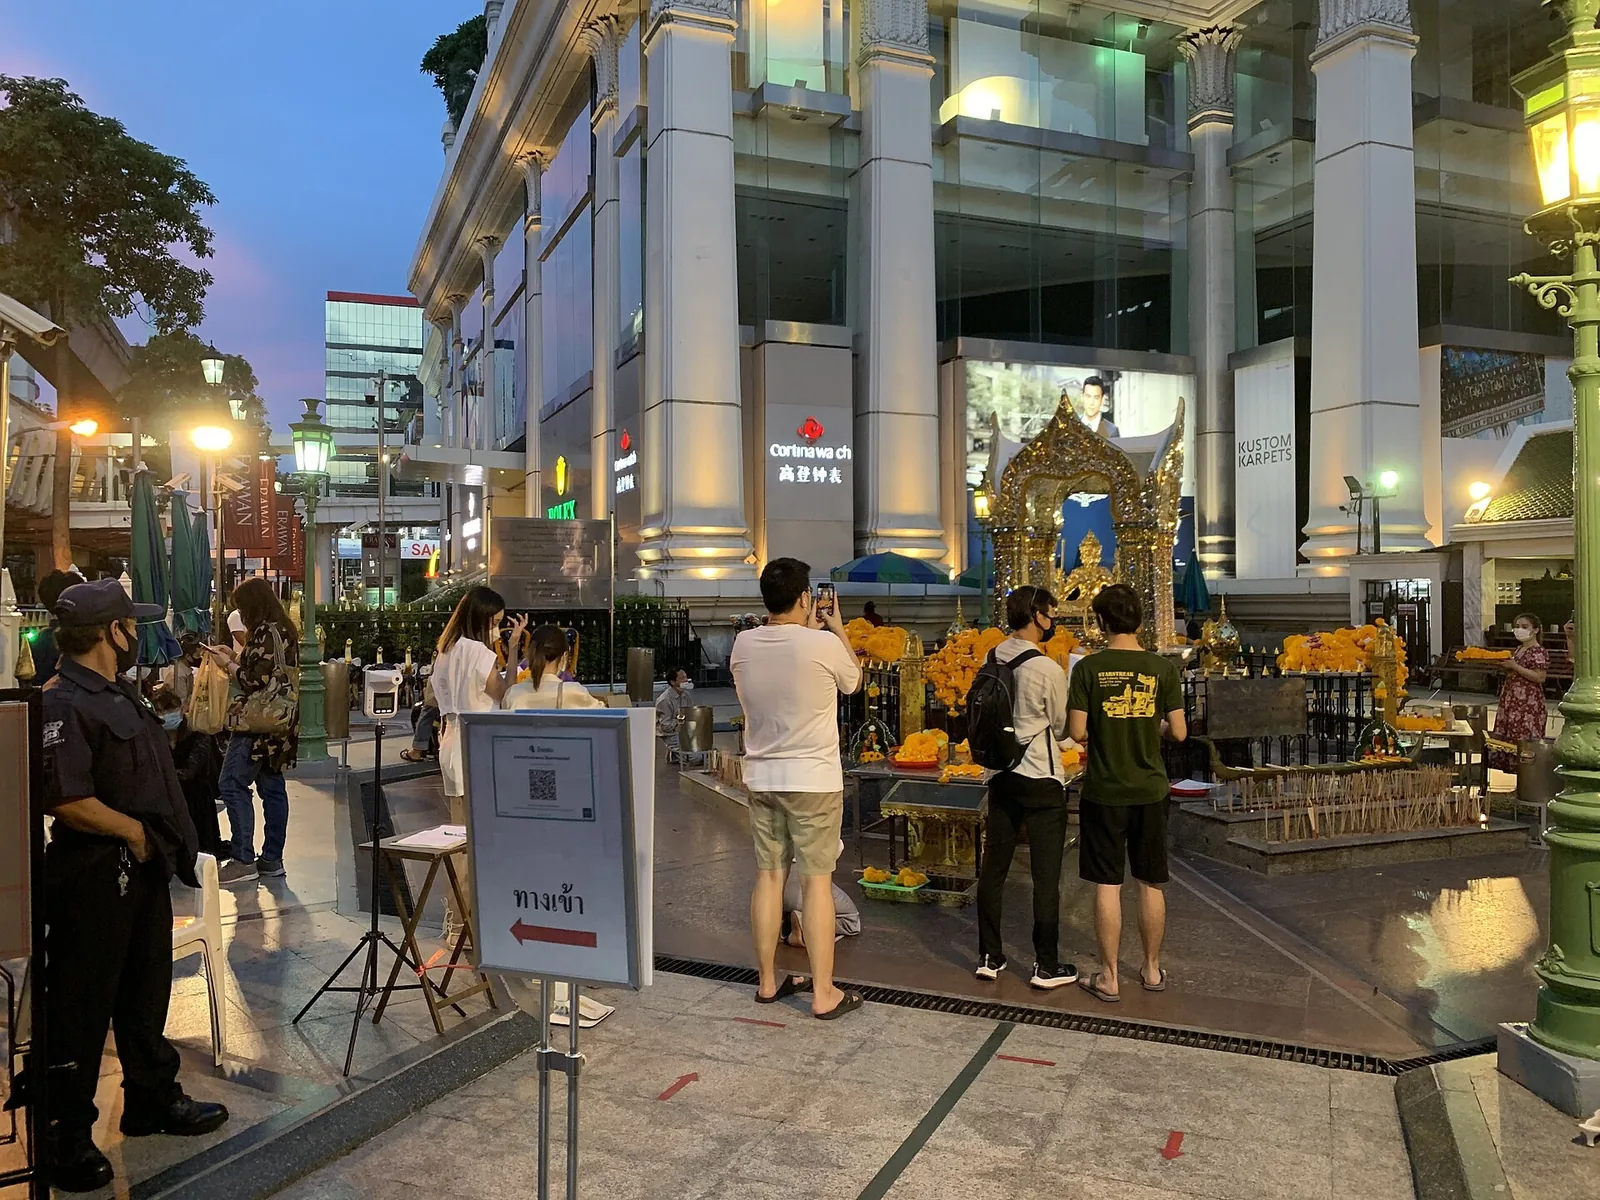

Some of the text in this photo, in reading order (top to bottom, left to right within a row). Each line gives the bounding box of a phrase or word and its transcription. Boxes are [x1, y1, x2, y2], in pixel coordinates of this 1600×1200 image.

[1238, 433, 1292, 454] KUSTOM
[1238, 448, 1292, 468] KARPETS
[779, 463, 842, 483] 高登钟表
[277, 510, 289, 556] ERAWAN
[513, 882, 584, 915] ทางเข้า
